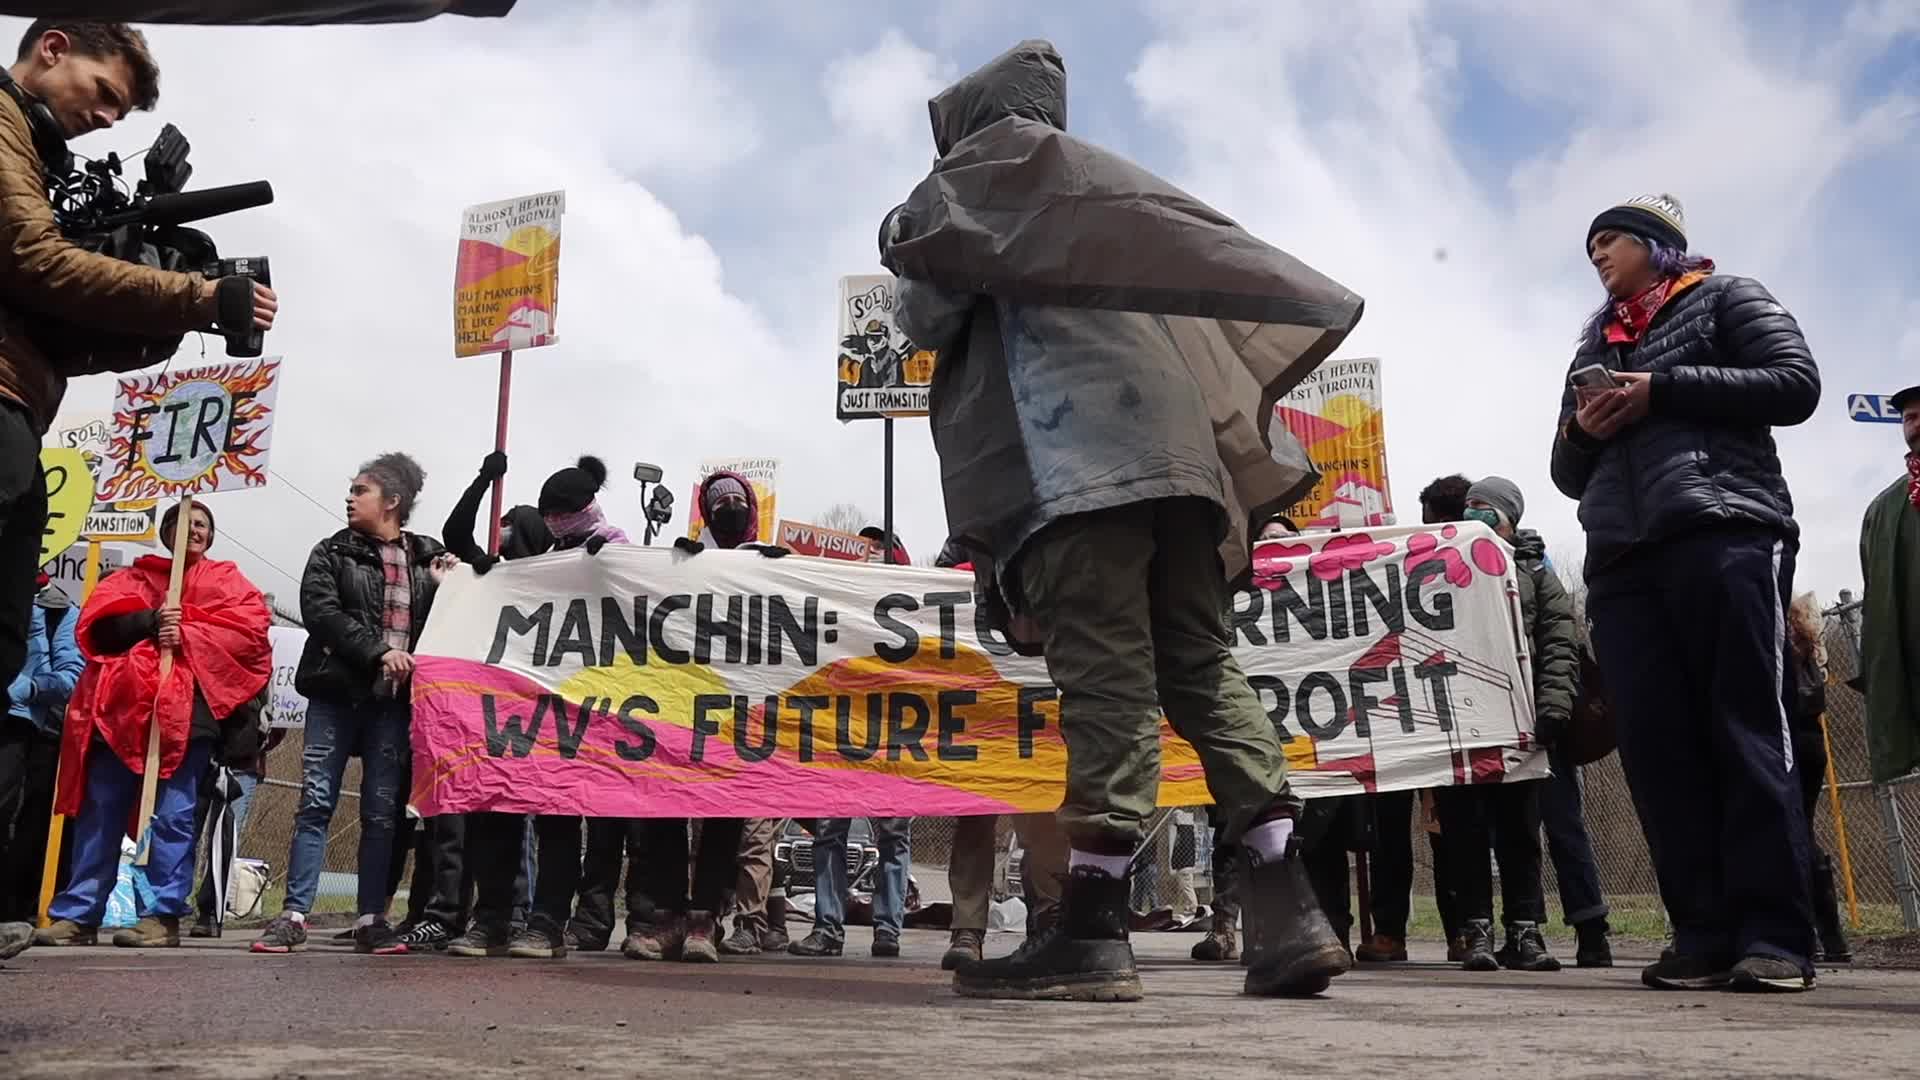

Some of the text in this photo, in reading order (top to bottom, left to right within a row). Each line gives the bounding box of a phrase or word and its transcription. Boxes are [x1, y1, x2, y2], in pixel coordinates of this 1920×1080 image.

[469, 195, 561, 223] ALMOST HEAVEN
[469, 208, 557, 234] WEST VIRGINIA
[458, 284, 543, 301] BUT MANCHIN'S
[457, 304, 500, 316] MAKING
[458, 317, 495, 331] IT LIKE
[1330, 361, 1378, 380] HEAVEN
[1289, 378, 1375, 401] EST VIRGINIA
[845, 391, 930, 408] JUST TRANSITIO
[124, 391, 257, 471] FIRE
[742, 459, 777, 470] HEAVEN
[1316, 459, 1369, 472] ANCHIN'S
[84, 516, 145, 531] RANSITION
[784, 527, 867, 555] WV RISING
[486, 593, 838, 668] MANCHIN:
[483, 694, 660, 760] WV'S
[690, 690, 977, 762] FUTURE
[1246, 661, 1458, 744] ROFIT
